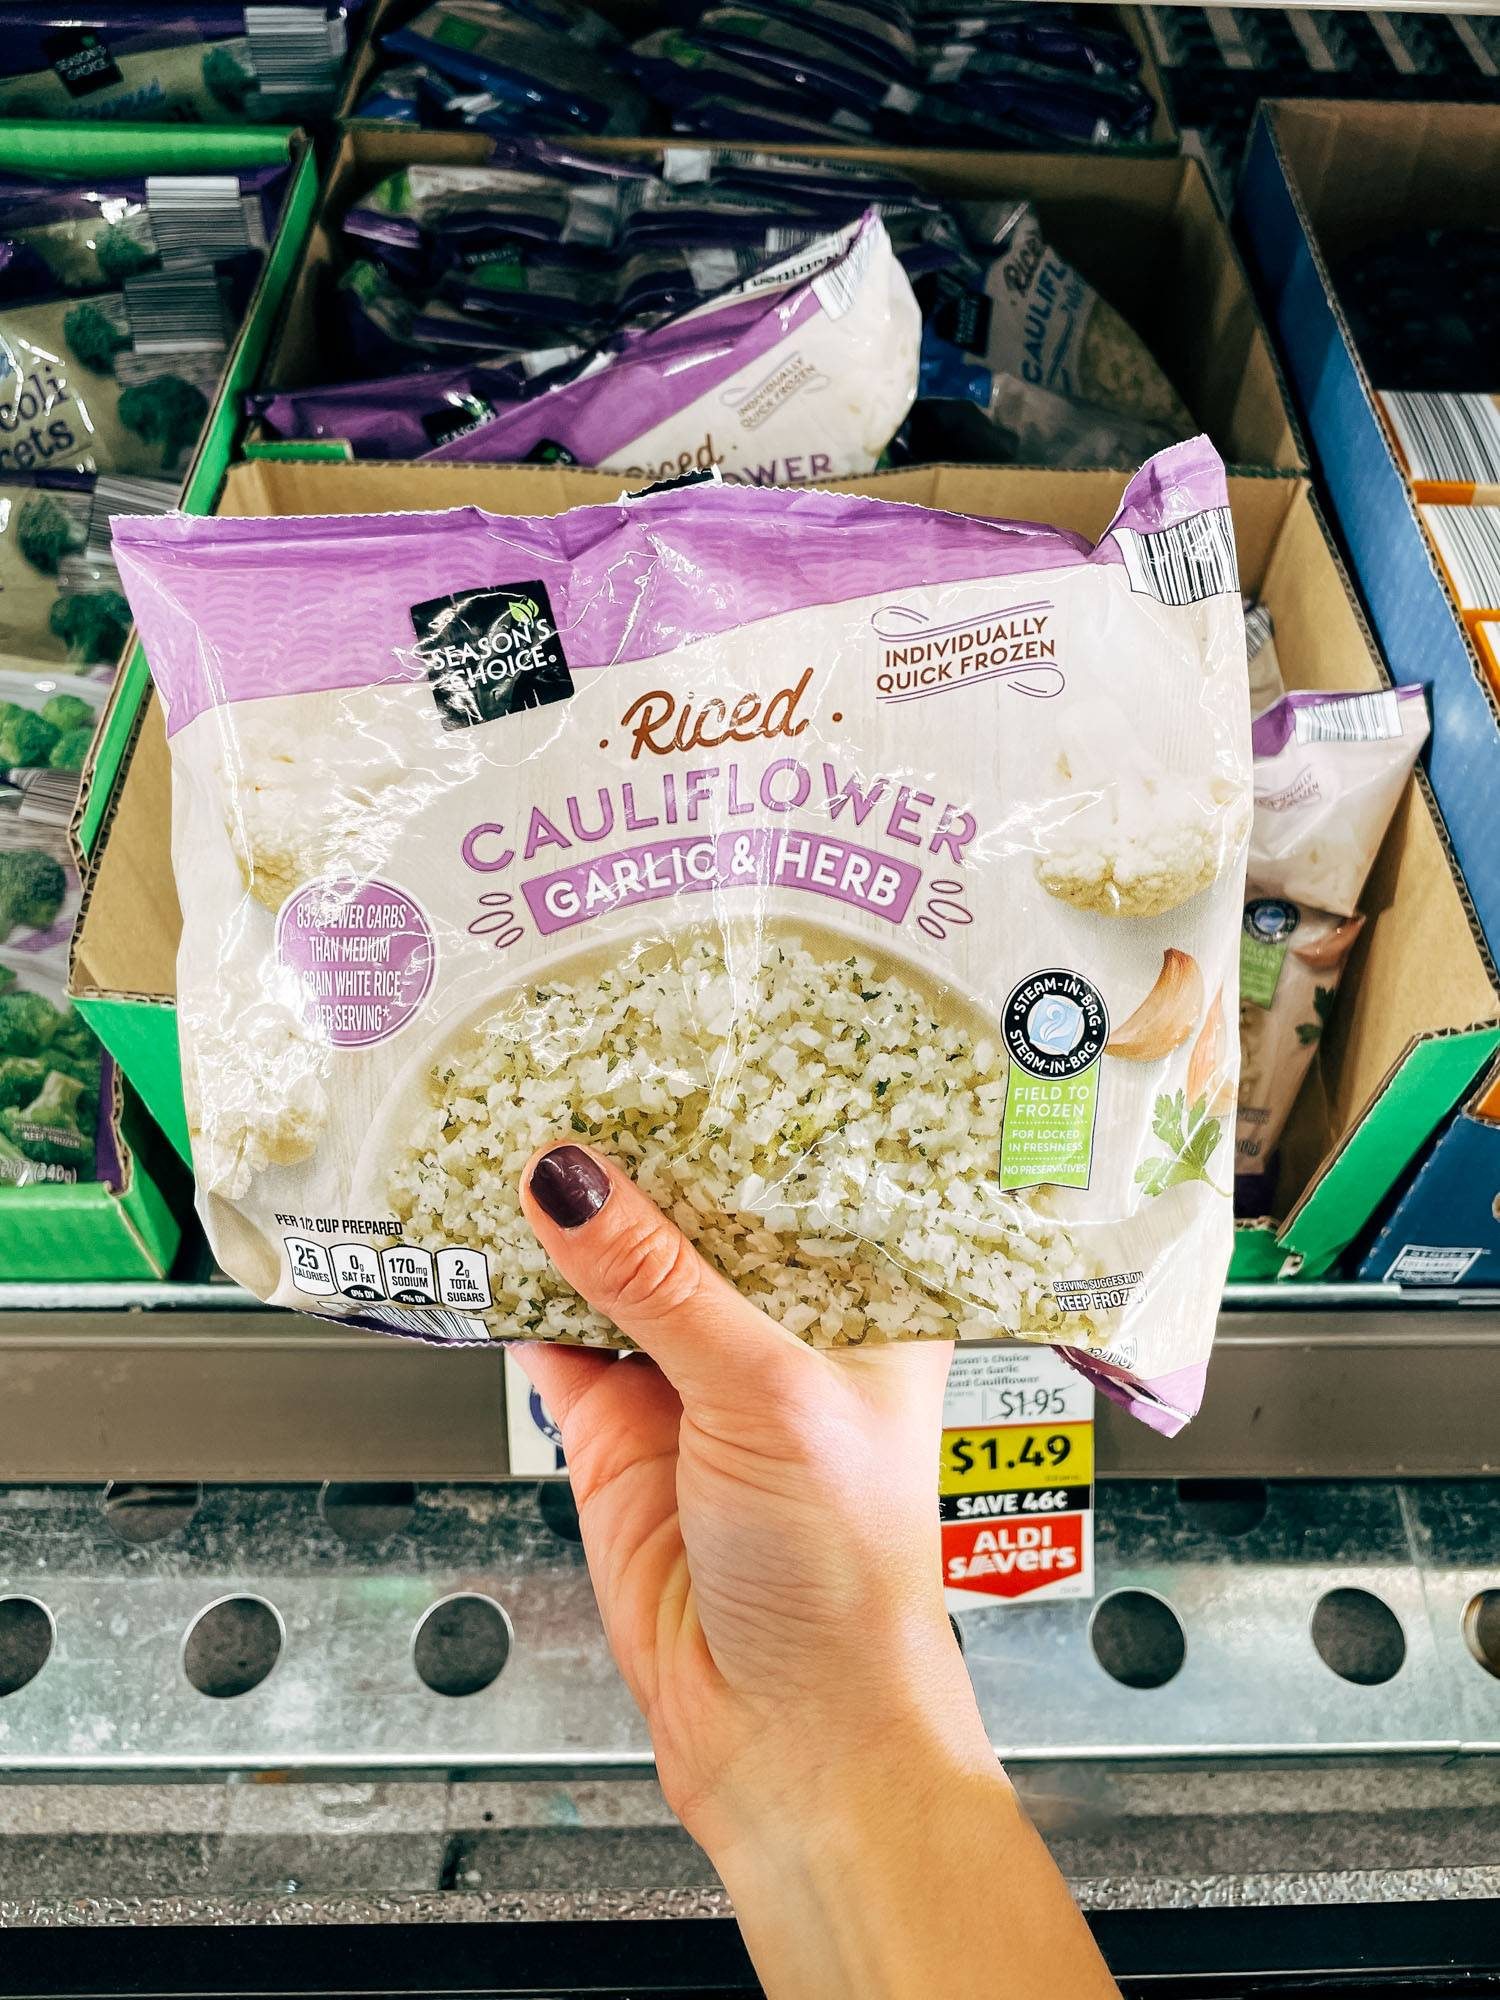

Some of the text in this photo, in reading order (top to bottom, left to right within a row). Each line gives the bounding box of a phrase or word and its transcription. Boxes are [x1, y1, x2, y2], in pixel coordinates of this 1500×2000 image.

[431, 619, 551, 671] SEASON'S
[884, 616, 1048, 668] INDIVIDUALLY
[875, 639, 1056, 694] QUICK FROZEN
[620, 667, 815, 760] Riced
[461, 758, 979, 874] CAULIFLOWER
[544, 835, 902, 919] GARLIC & HERB
[367, 904, 407, 929] CARBS
[309, 936, 390, 962] THAN MEDIUM
[335, 971, 371, 996] WHITE
[373, 971, 401, 996] RICE
[1014, 977, 1102, 1027] STEAM-IN-BAG
[1010, 1029, 1098, 1074] STEAM-IN-BAG
[1014, 1086, 1089, 1101] FIELD TO
[1015, 1103, 1085, 1118] FROZEN
[1012, 1129, 1081, 1139] FOR LOCKED
[1009, 1141, 1083, 1153] IN FRESHNESS
[1003, 1163, 1087, 1175] NO PRESERVATIVES
[274, 1213, 403, 1237] PER 1/2 CUP PREPARED
[295, 1244, 319, 1270] 25
[389, 1257, 428, 1277] 170mg
[455, 1260, 470, 1278] 2g
[293, 1267, 330, 1283] CALORIES
[342, 1271, 376, 1284] SAT FAT
[391, 1276, 428, 1288] SODIUM
[449, 1278, 479, 1290] TOTAL
[1053, 1271, 1144, 1292] SERVING SUGGESTION
[447, 1292, 485, 1303] SUGARS
[1057, 1295, 1091, 1312] KEEP
[999, 1388, 1066, 1418] $1.95
[952, 1435, 1071, 1475] $1.49
[957, 1490, 1068, 1517] SAVE 46¢
[973, 1525, 1053, 1554] ALDI
